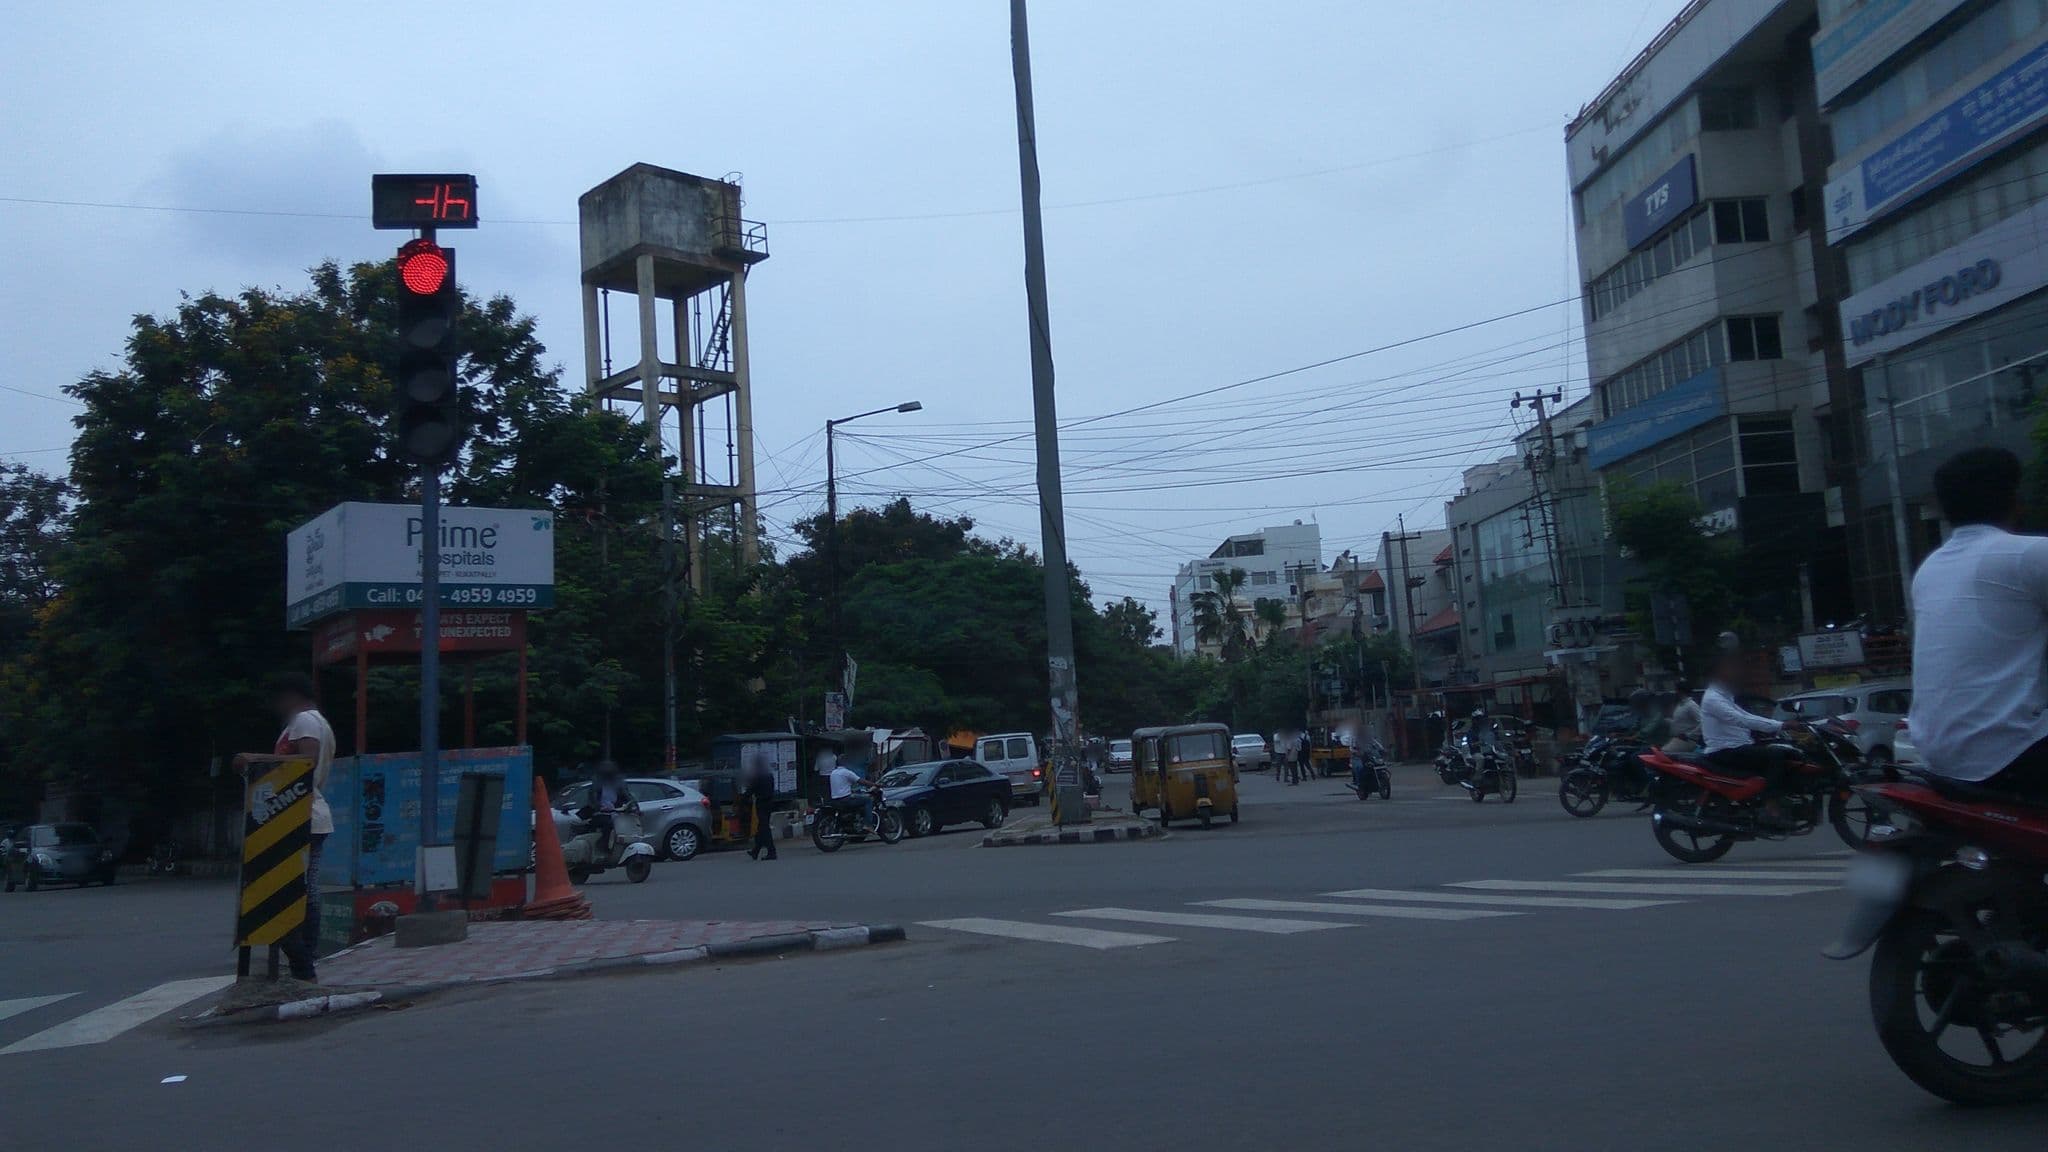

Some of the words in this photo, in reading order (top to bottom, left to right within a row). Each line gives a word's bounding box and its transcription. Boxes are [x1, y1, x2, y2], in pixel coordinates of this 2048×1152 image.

[1645, 183, 1671, 217] TVS
[1924, 258, 2002, 314] FORD
[407, 517, 497, 549] Pime
[418, 550, 495, 567] Hspitals
[366, 588, 401, 603] Call:
[451, 588, 492, 603] 4959
[496, 588, 537, 604] 4959
[466, 613, 513, 625] EXPECT
